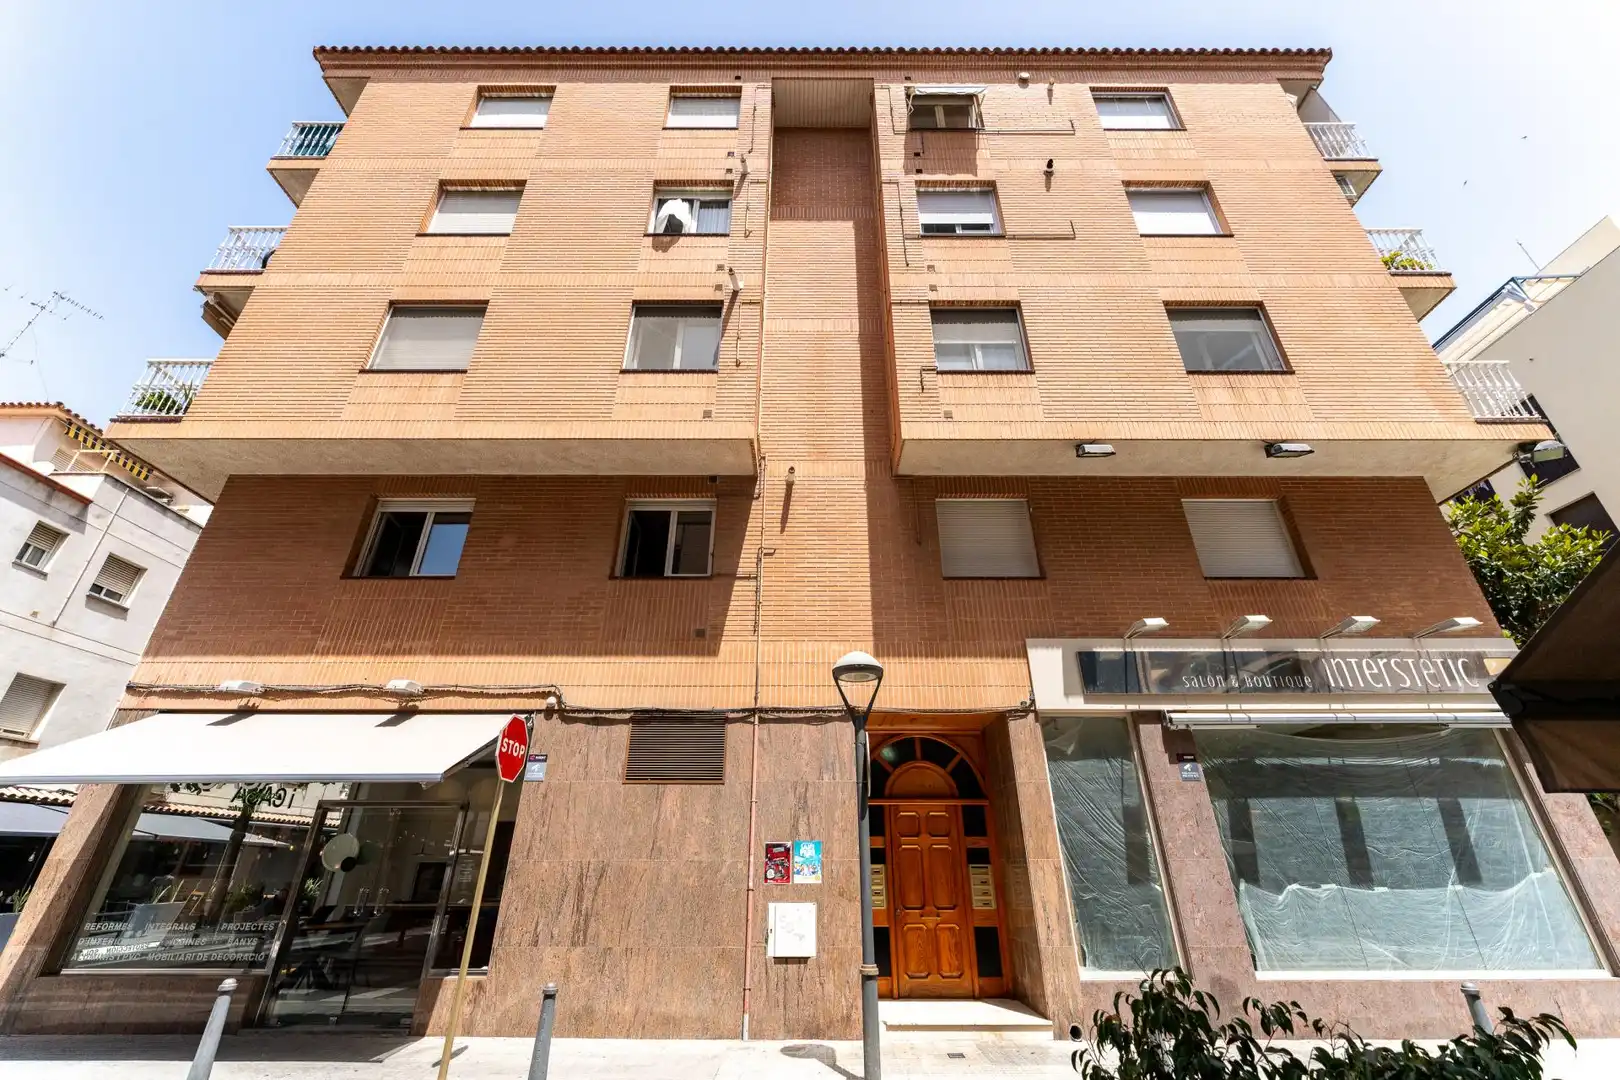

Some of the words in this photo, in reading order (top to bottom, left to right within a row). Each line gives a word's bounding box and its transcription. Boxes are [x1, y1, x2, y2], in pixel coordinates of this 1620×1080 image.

[501, 737, 526, 759] STOP
[84, 922, 134, 931] REFORMES
[145, 922, 197, 931] INTEGRALS
[221, 922, 275, 931] PROJECTES
[227, 938, 258, 946] BANYS
[147, 953, 194, 961] MOBILIARI
[195, 953, 209, 961] DE
[210, 952, 265, 961] DECORACIÓ
